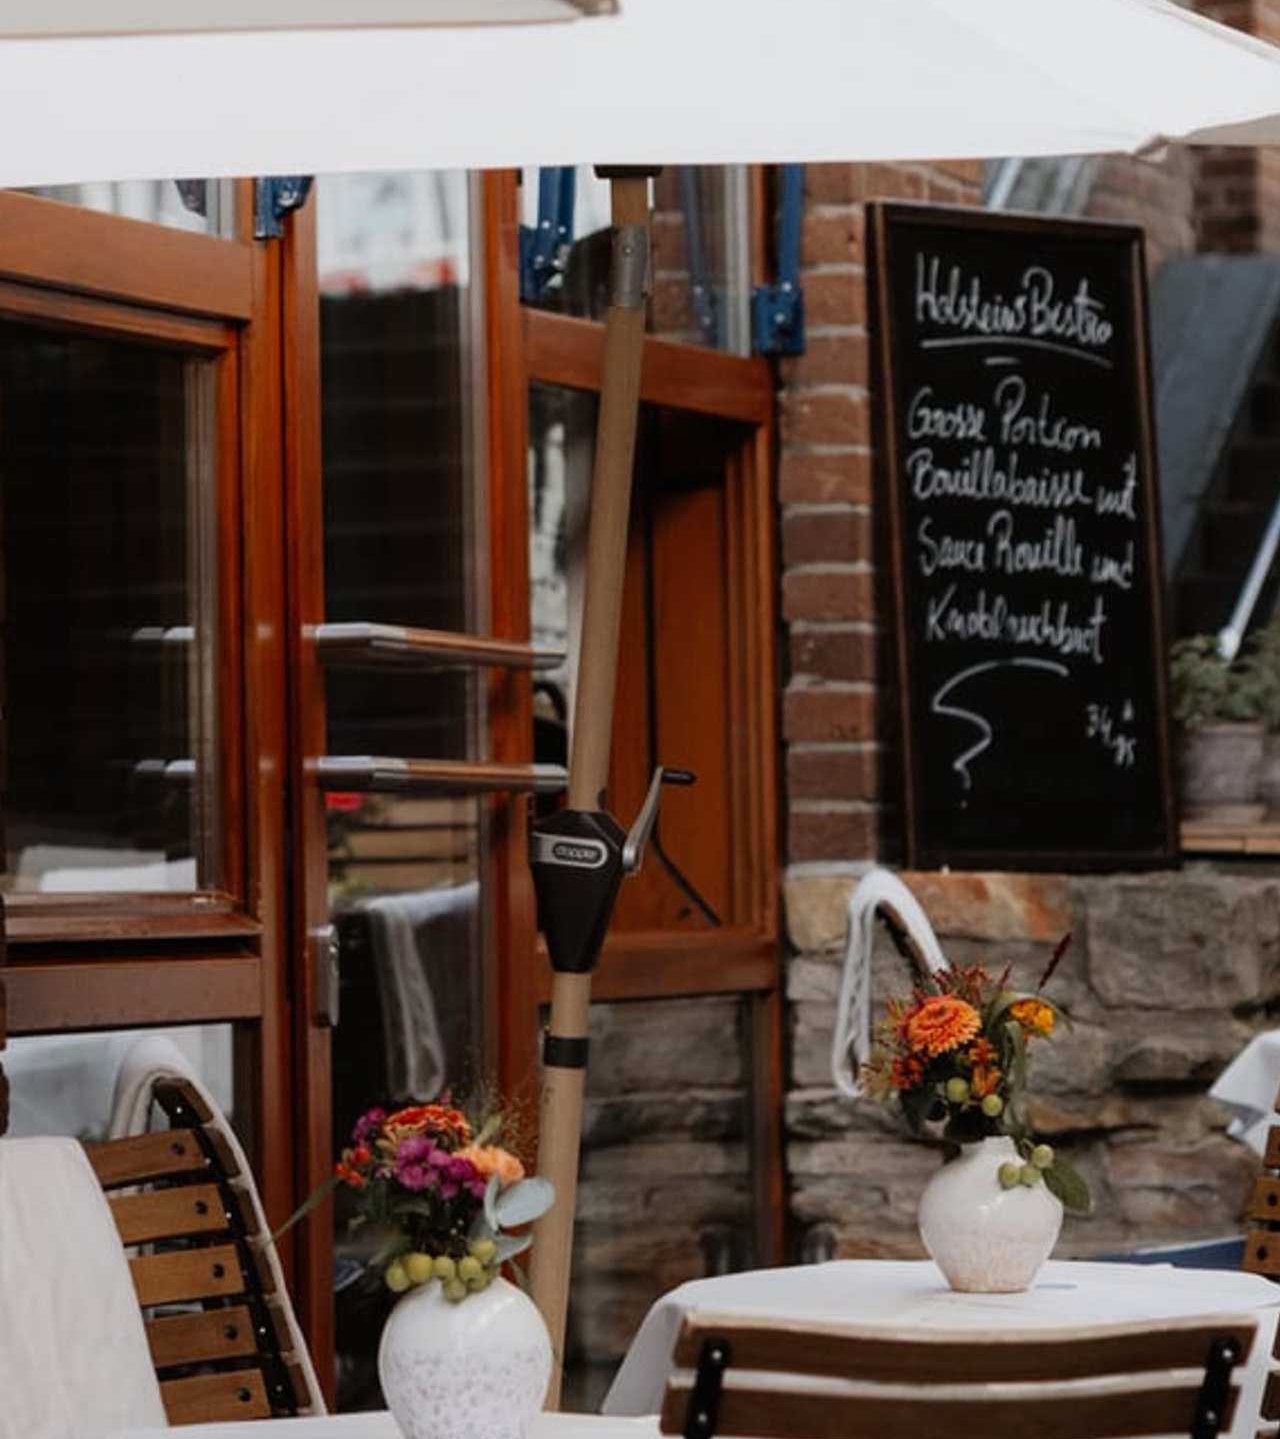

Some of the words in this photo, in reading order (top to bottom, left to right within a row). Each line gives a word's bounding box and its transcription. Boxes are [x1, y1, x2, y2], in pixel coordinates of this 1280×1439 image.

[995, 375, 1102, 451] Portion
[906, 446, 1092, 511] Bouillabaisse
[1096, 451, 1138, 520] mit
[917, 516, 985, 577] Sauce
[986, 509, 1083, 576] Rouille
[1090, 541, 1135, 589] und
